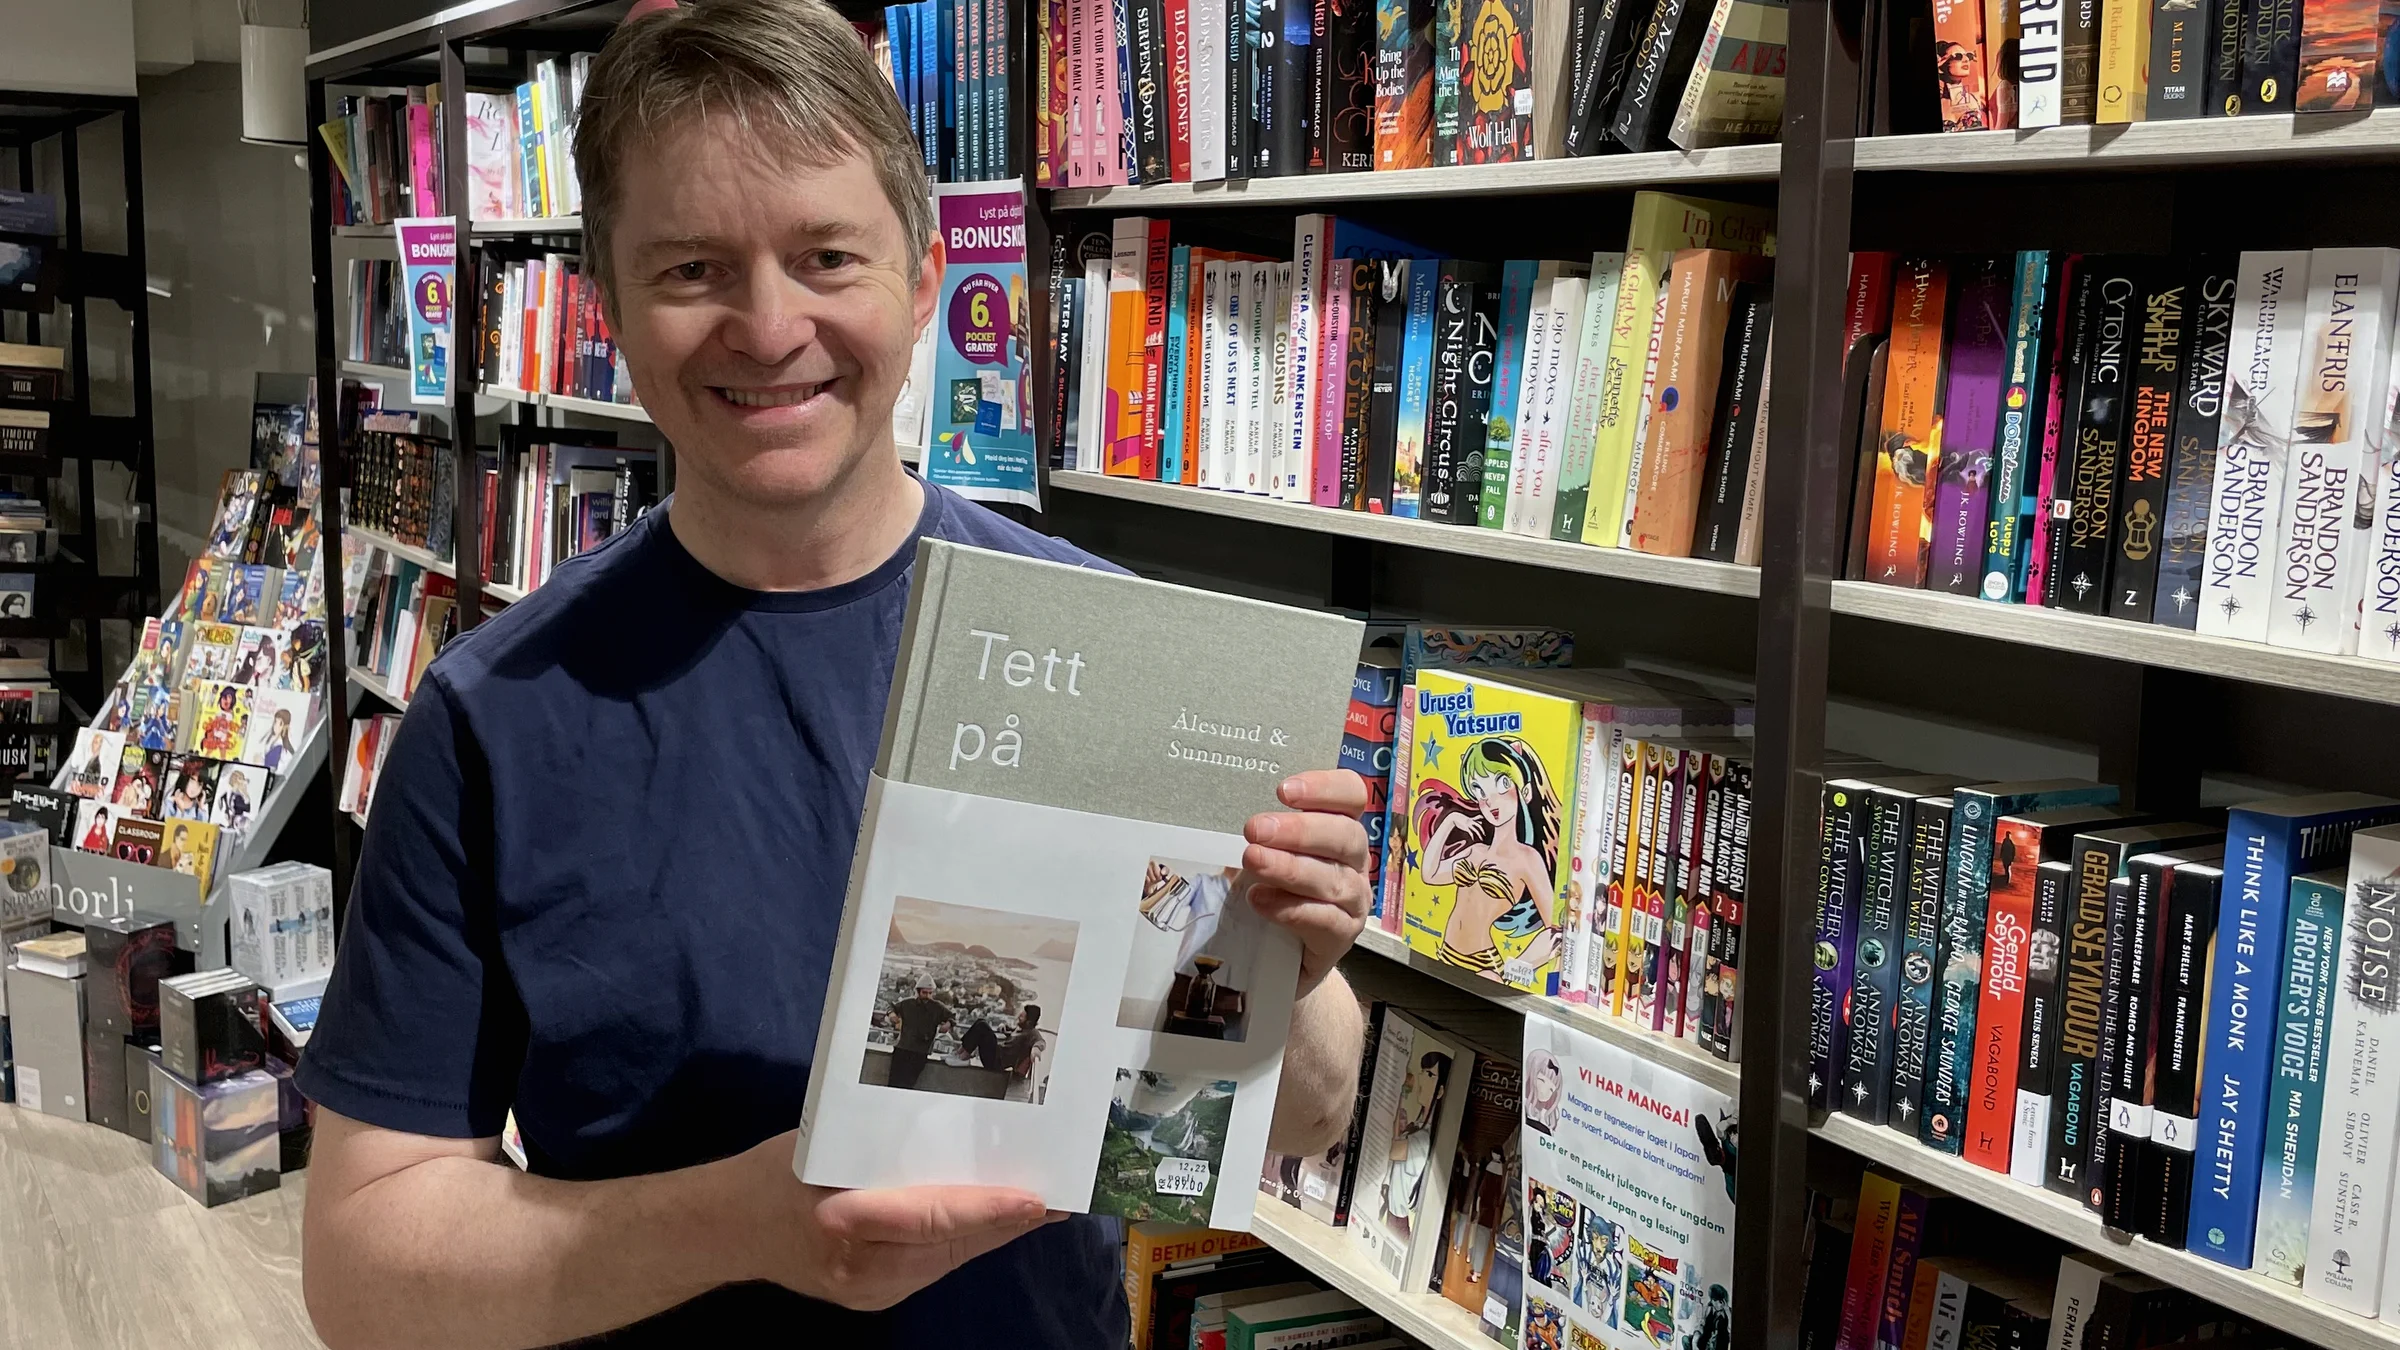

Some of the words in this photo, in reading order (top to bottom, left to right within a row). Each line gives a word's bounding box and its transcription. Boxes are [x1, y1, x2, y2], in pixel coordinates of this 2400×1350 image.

[956, 5, 964, 48] MAYBE
[1095, 4, 1103, 26] KILL
[1095, 28, 1103, 54] YOUR
[1378, 49, 1402, 66] Bring
[2108, 7, 2123, 71] Richardson
[957, 53, 965, 82] NOW
[1095, 56, 1104, 90] FAMILY
[1376, 67, 1389, 83] Up
[1390, 65, 1405, 79] the
[1633, 26, 1675, 109] MARTIN
[2171, 50, 2181, 73] RIO
[1376, 82, 1404, 98] Bodies
[2163, 86, 2186, 94] TITAN
[1468, 121, 1492, 150] Wolf
[1493, 119, 1518, 146] Hall
[980, 207, 996, 221] Lyst
[998, 205, 1008, 219] på
[951, 224, 1025, 249] BONUSKO
[1114, 250, 1136, 258] Lessons
[1152, 236, 1166, 271] THE
[963, 284, 971, 293] DU
[984, 280, 999, 293] HVER
[1300, 234, 1313, 313] CLEOPATRA
[1680, 271, 1692, 315] HARUKI
[971, 292, 993, 328] 6.
[1061, 285, 1072, 328] PETER
[1148, 274, 1164, 327] ISLAND
[1229, 296, 1239, 317] ONE
[966, 332, 996, 342] POCKET
[1059, 332, 1070, 362] MAY
[1229, 321, 1238, 337] OF
[1300, 318, 1308, 342] and
[1552, 309, 1566, 344] jojo
[2098, 277, 2133, 384] CYTONIC
[2140, 293, 2166, 365] SMITH
[2155, 286, 2184, 373] WILBUR
[2195, 275, 2237, 417] SKYWARD
[2321, 273, 2358, 392] ELANTRIS
[1227, 342, 1237, 357] US
[1227, 361, 1236, 374] IS
[1273, 332, 1287, 405] COUSINS
[1329, 343, 1337, 371] ONE
[1441, 318, 1464, 396] Night
[1669, 318, 1687, 382] MURAKAMI
[1146, 363, 1157, 401] ADRIAN
[1226, 377, 1236, 406] NEXT
[1292, 346, 1307, 450] FRANKENSTEIN
[1326, 373, 1336, 405] LAST
[1543, 349, 1562, 405] moyes
[1144, 403, 1155, 448] McKINTY
[1324, 409, 1334, 441] STOP
[2151, 392, 2171, 425] THE
[1437, 400, 1457, 480] Circus
[1538, 429, 1553, 464] after
[2128, 386, 2154, 482] KINGDOM
[2147, 428, 2168, 479] NEW
[1341, 435, 1349, 483] MILLER
[1348, 427, 1358, 490] MADELINE
[1483, 458, 1509, 469] APPLES
[1484, 472, 1505, 482] NEVER
[1486, 485, 1501, 495] FALL
[1531, 468, 1543, 497] you
[2285, 451, 2323, 601] SANDERSON
[2313, 467, 2348, 591] BRANDON
[969, 628, 1086, 696] Tett
[1419, 687, 1473, 715] Urusei
[949, 713, 1023, 770] på
[1172, 707, 1262, 743] Ålesund
[1270, 728, 1289, 748] &
[1445, 712, 1522, 738] Yatsura
[0, 747, 28, 766] USK
[1167, 739, 1281, 775] Sunnmøre
[1427, 739, 1436, 757] 1
[1616, 772, 1633, 850] CHAINSAW
[1680, 783, 1697, 856] CHAINSAW
[1884, 802, 1900, 847] THE
[118, 826, 160, 840] CLASSROOM
[1929, 818, 1945, 861] THE
[1613, 851, 1626, 876] MAN
[1677, 858, 1690, 890] MAN
[1729, 846, 1747, 893] KAISEN
[2242, 835, 2266, 905] THINK
[1612, 890, 1617, 904] 1
[1875, 850, 1896, 932] WITCHER
[1917, 865, 1940, 949] WITCHER
[2079, 850, 2109, 925] GERALD
[2139, 873, 2149, 915] WILLIAM
[2132, 916, 2144, 985] SHAKESPEARE
[2184, 914, 2194, 944] MARY
[2239, 908, 2257, 956] LIKE
[2357, 885, 2398, 1004] NOISE
[1987, 910, 2014, 1002] Seymour
[2002, 913, 2026, 993] Gerald
[2180, 945, 2191, 985] SHELLEY
[2235, 959, 2244, 977] A
[2287, 918, 2320, 1018] ARCHER'S
[1942, 980, 1963, 1036] GEORGE
[2061, 923, 2107, 1060] SEYMOUR
[2227, 981, 2249, 1051] MONK
[1983, 1024, 2004, 1112] VAGABOND
[2279, 1016, 2309, 1080] VOICE
[1935, 1037, 1955, 1106] SAUNDERS
[1579, 1066, 1591, 1084] VI
[1596, 1075, 1623, 1098] HAR
[1628, 1089, 1689, 1128] MANGA!
[2065, 1063, 2083, 1147] VAGABOND
[2222, 1074, 2243, 1115] JAY
[2289, 1089, 2303, 1118] MIA
[1562, 1108, 1572, 1120] De
[1573, 1116, 1580, 1125] er
[1581, 1120, 1602, 1136] svært
[1604, 1132, 1642, 1156] populære
[1643, 1150, 1665, 1167] blant
[1667, 1163, 1705, 1185] ungdom!
[1568, 1092, 1592, 1112] Manga
[1594, 1107, 1602, 1116] er
[1604, 1110, 1646, 1135] tegneserier
[1647, 1130, 1668, 1148] laget
[1674, 1142, 1700, 1163] Japan
[1179, 1162, 1206, 1173] 12.22
[2212, 1117, 2236, 1200] SHETTY
[2277, 1119, 2300, 1199] SHERIDAN
[1539, 1137, 1557, 1152] Det
[1559, 1145, 1568, 1156] er
[1570, 1152, 1580, 1164] en
[1582, 1158, 1615, 1182] perfekt
[1617, 1170, 1659, 1204] julegave
[1662, 1195, 1677, 1212] for
[1680, 1207, 1725, 1234] ungdom
[1566, 1174, 1584, 1188] som
[1585, 1182, 1606, 1201] liker
[1607, 1196, 1637, 1218] Japan
[1640, 1211, 1653, 1227] og
[1655, 1219, 1690, 1244] lesing!
[1152, 1242, 1196, 1263] BETH
